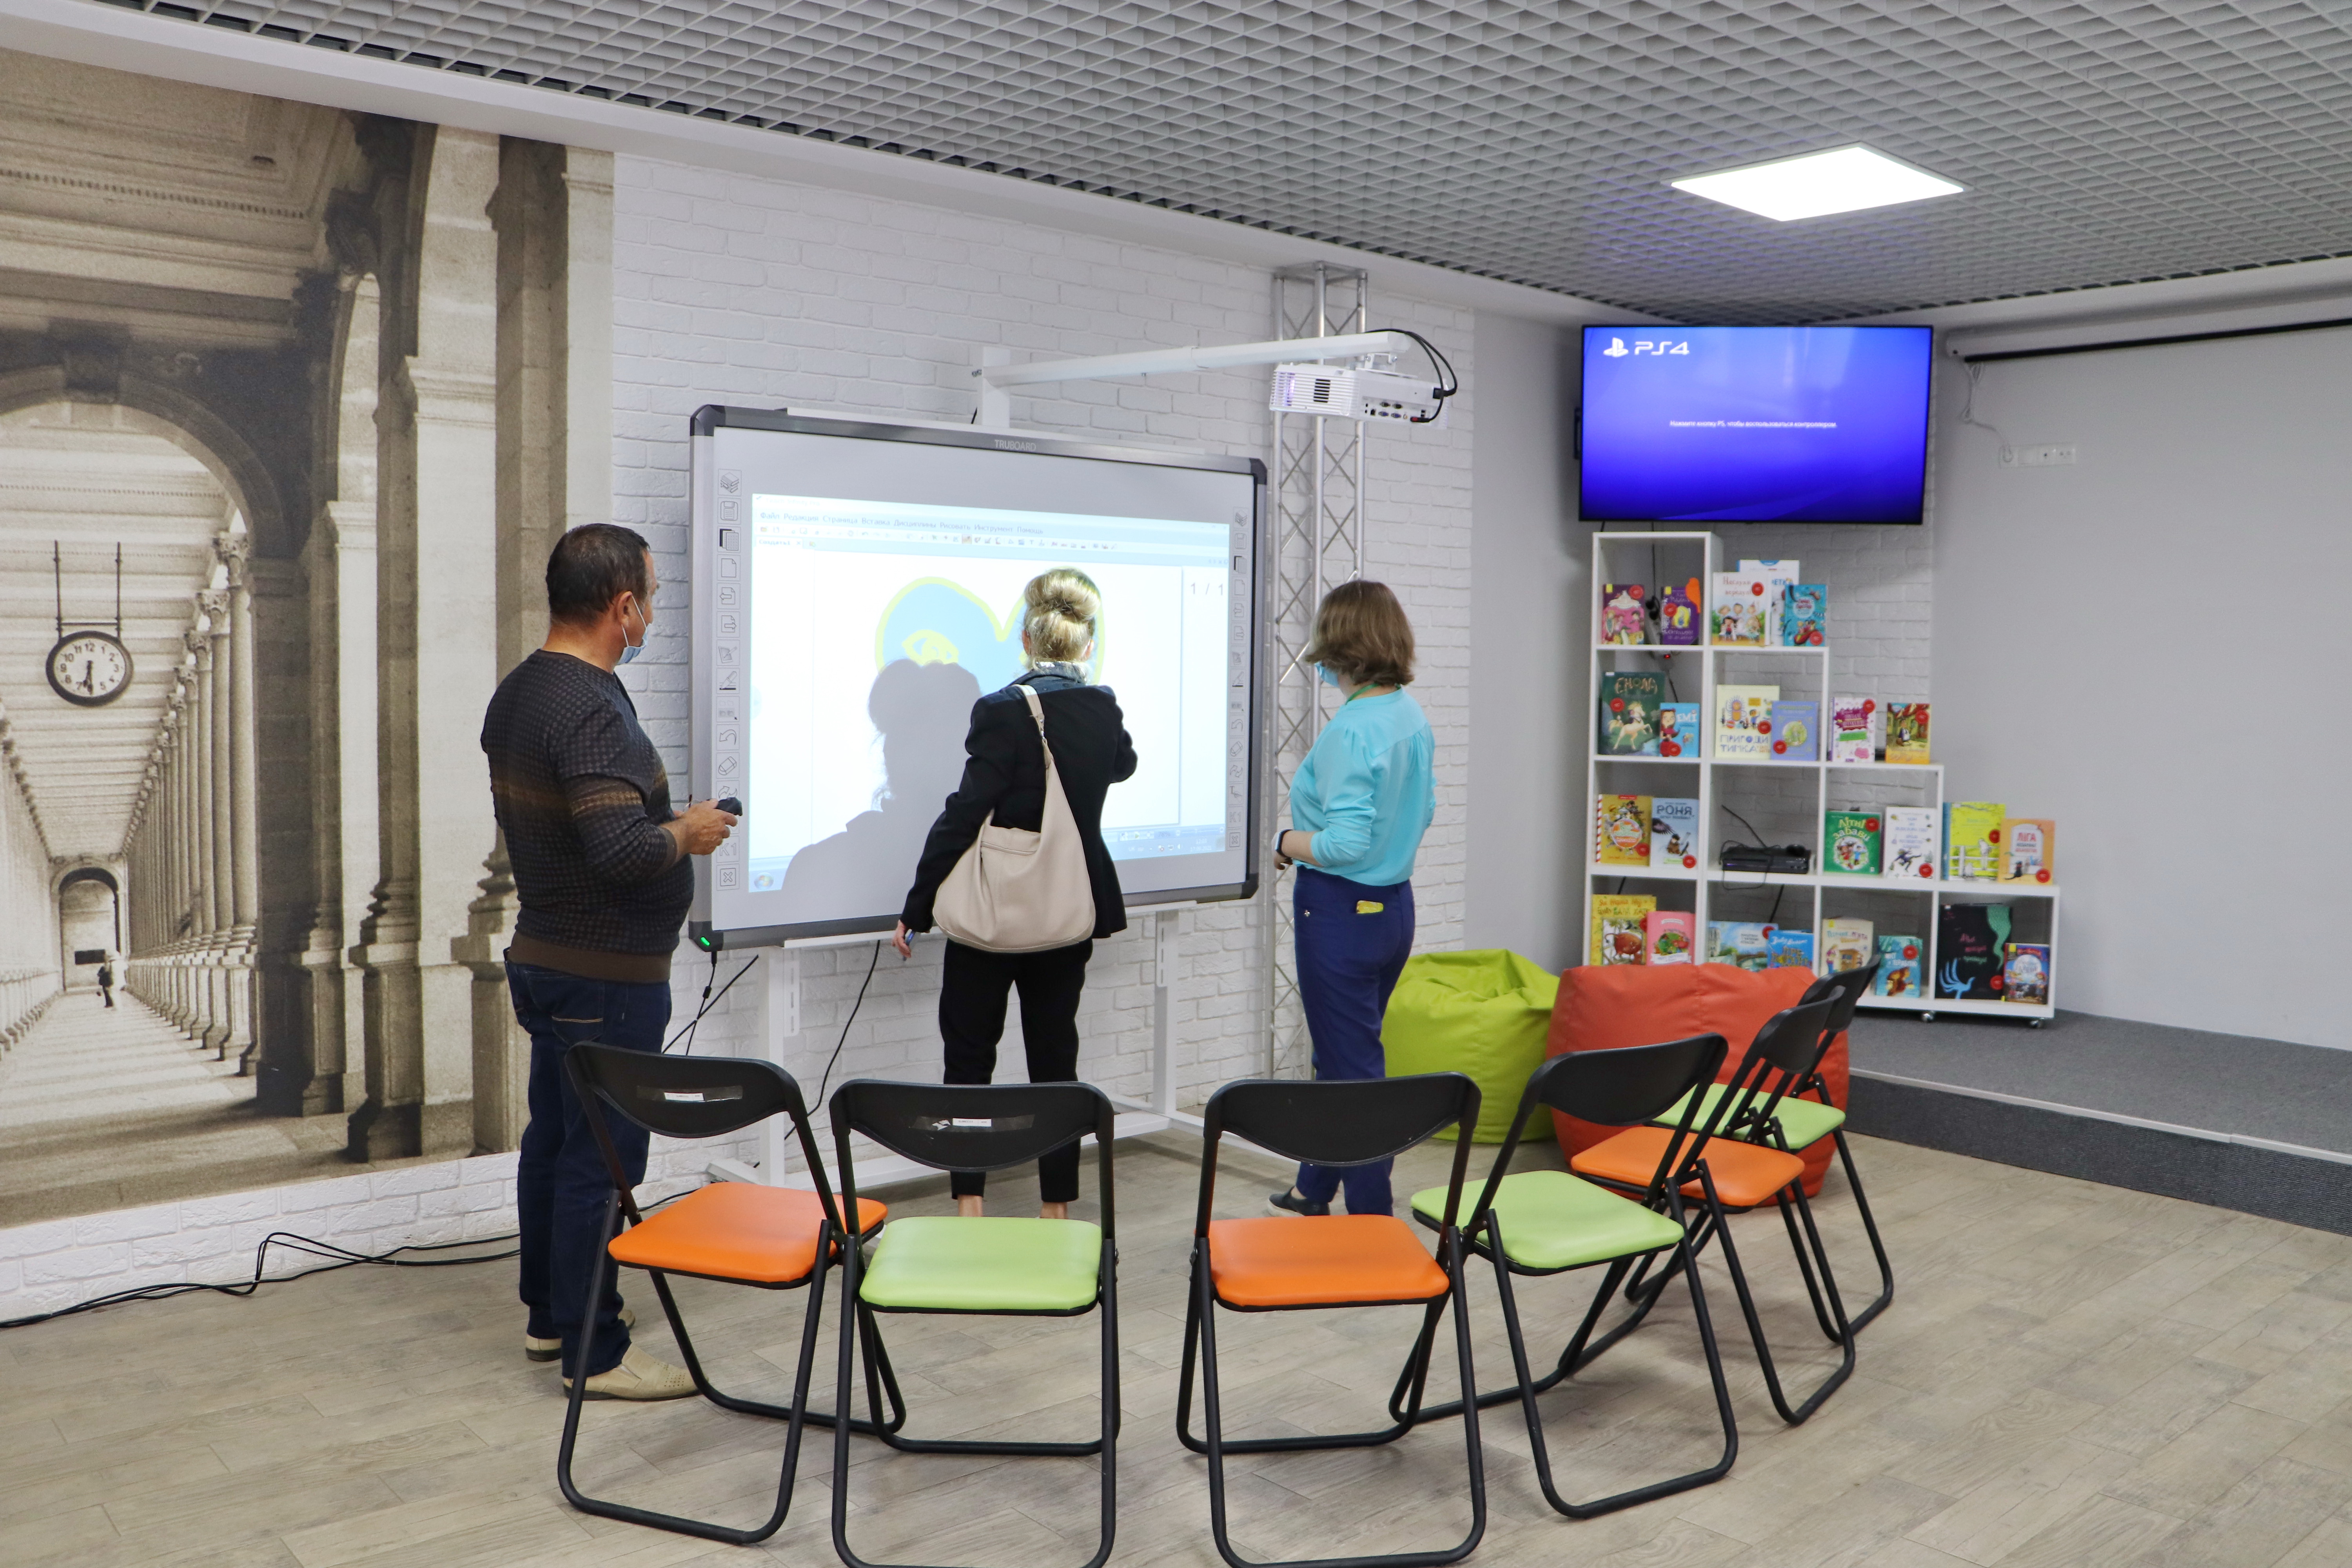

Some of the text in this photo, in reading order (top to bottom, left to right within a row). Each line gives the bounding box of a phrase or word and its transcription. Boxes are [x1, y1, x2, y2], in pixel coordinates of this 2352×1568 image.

[1634, 341, 1690, 356] PS4
[995, 439, 1036, 451] TRUBOARD
[784, 513, 818, 522] Редакция
[822, 515, 858, 524] Страница
[861, 517, 890, 526] Вставка
[894, 519, 936, 528] Дисциплины
[940, 522, 971, 530] Рисовать
[975, 524, 1013, 532] Инструмент
[1017, 526, 1044, 534] Помощь
[1191, 582, 1196, 595] 1
[1218, 583, 1223, 595] 1
[85, 643, 95, 652] 12
[64, 653, 115, 662] 10 2
[60, 663, 119, 672] 9 3
[1720, 735, 1769, 744] ПРИГОДИ
[2017, 832, 2036, 842] ЛІГА
[719, 842, 737, 856] K1
